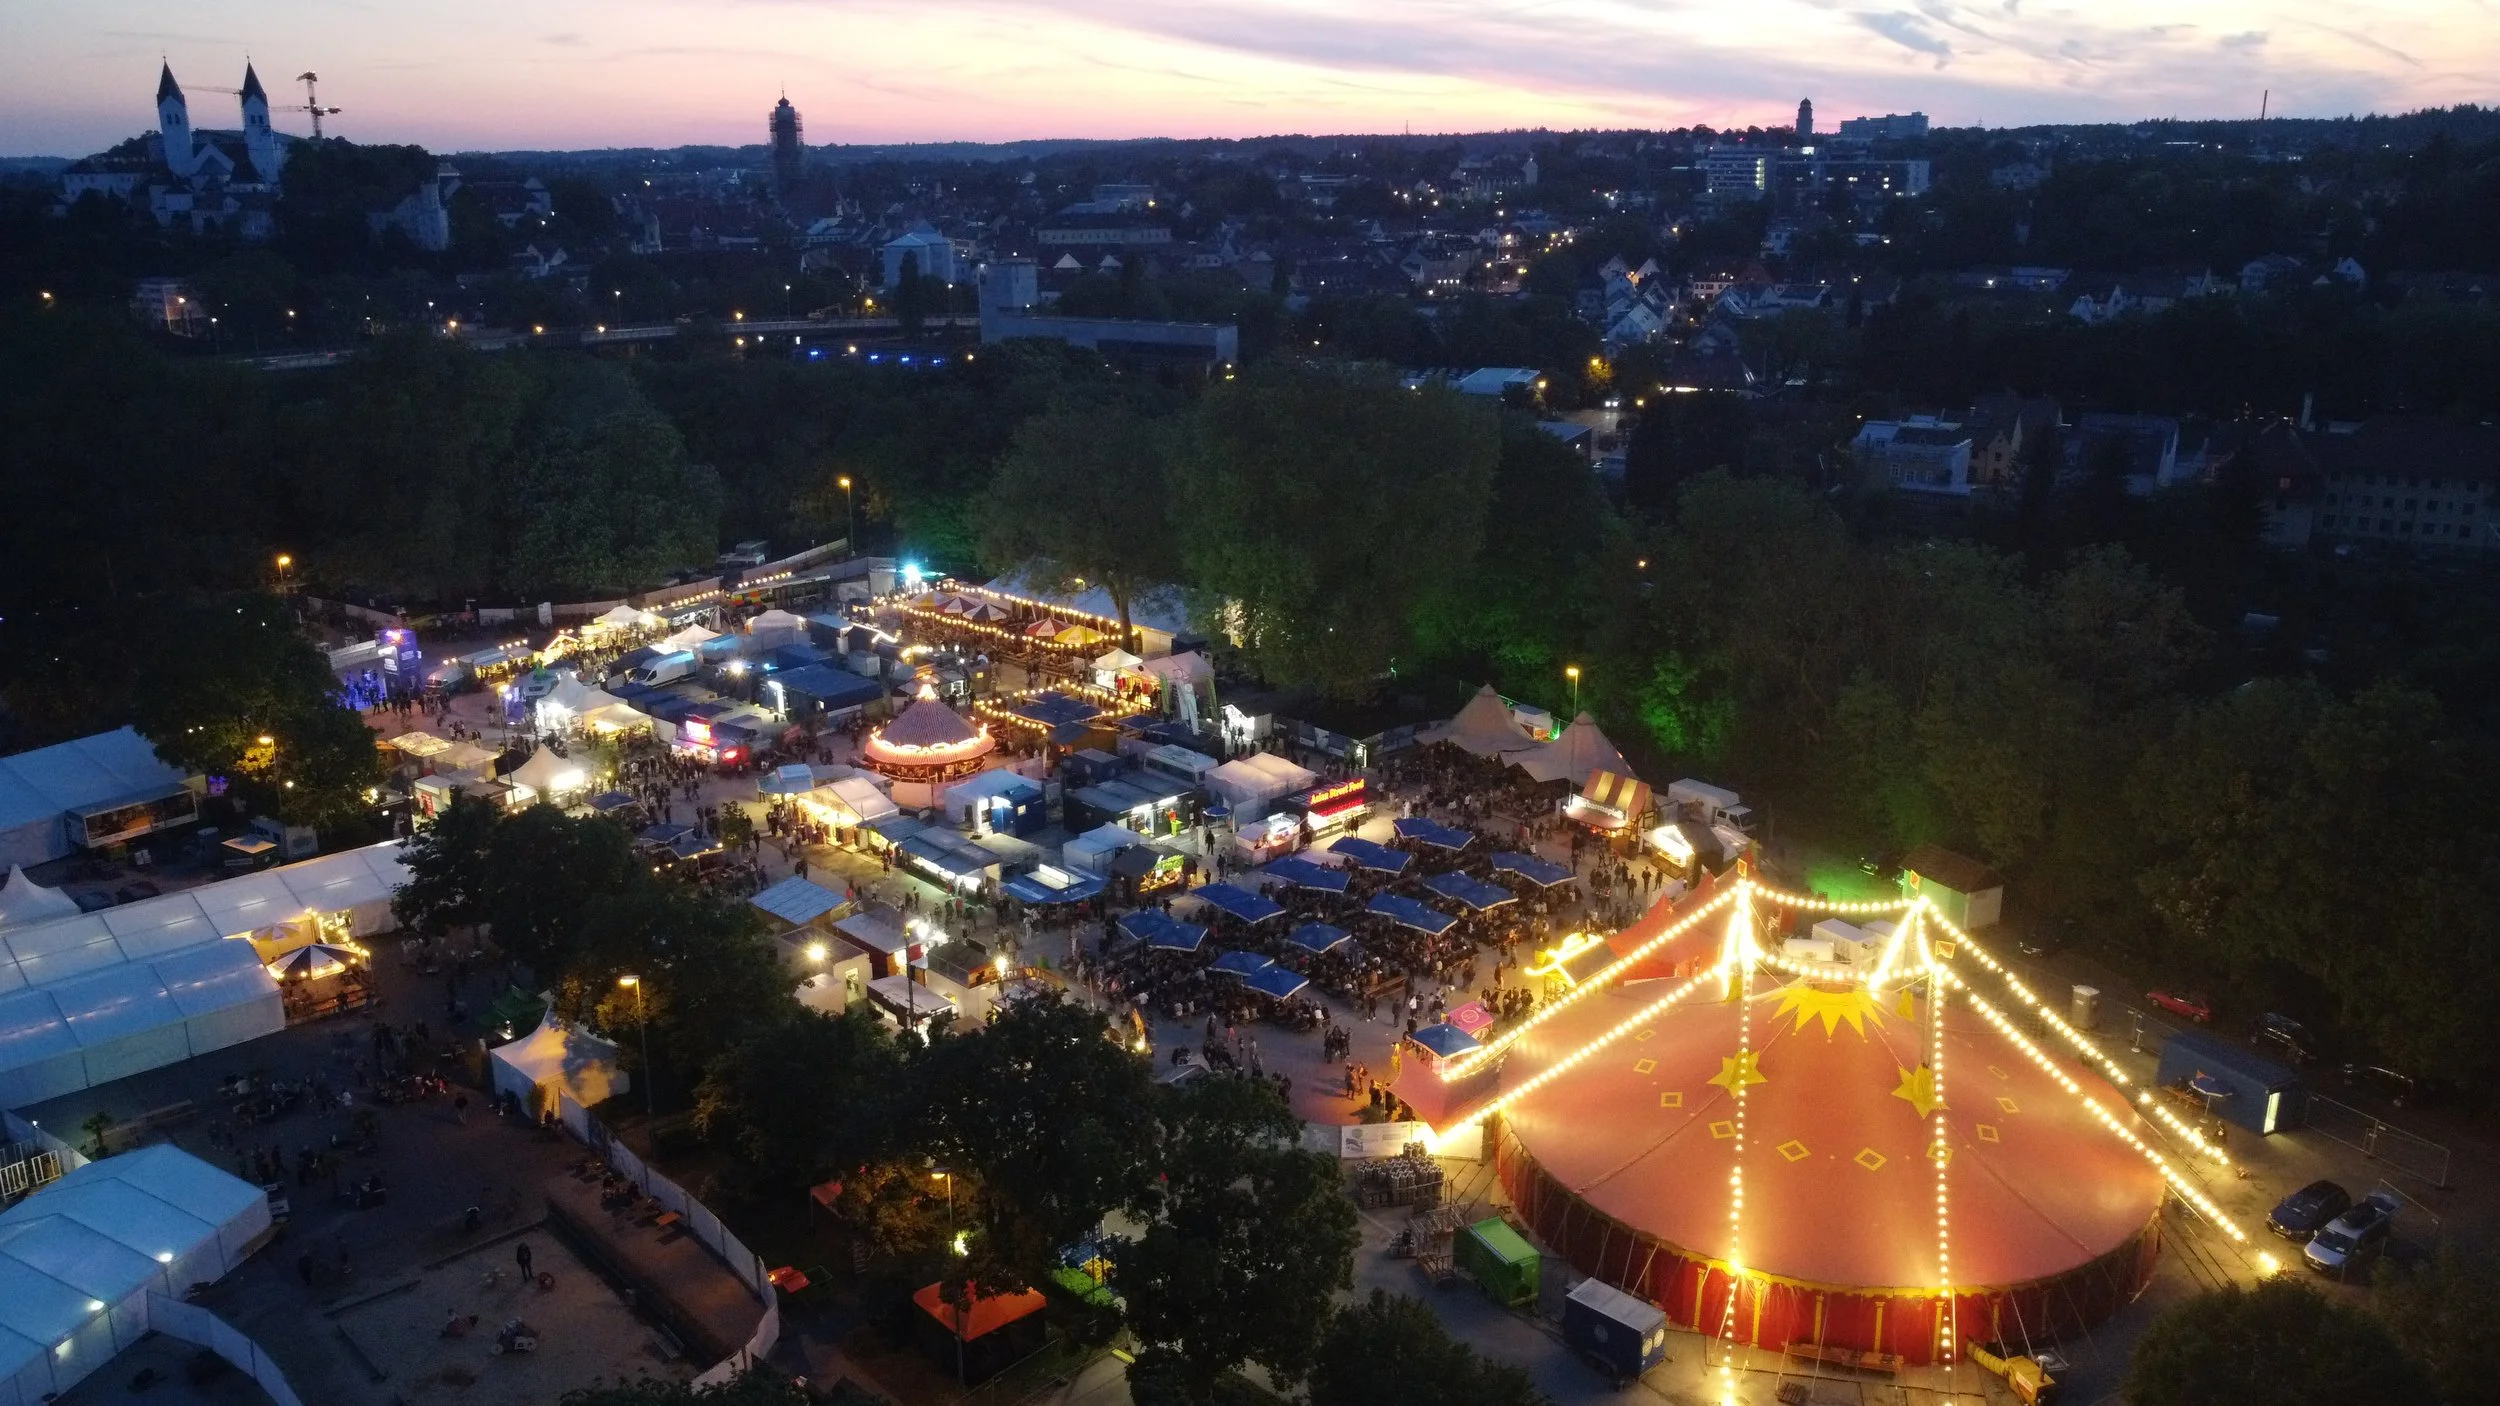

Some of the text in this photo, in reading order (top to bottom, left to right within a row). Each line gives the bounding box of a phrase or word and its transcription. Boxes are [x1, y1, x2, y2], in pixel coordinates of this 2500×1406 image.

[1311, 778, 1365, 804] Asian Street Food
